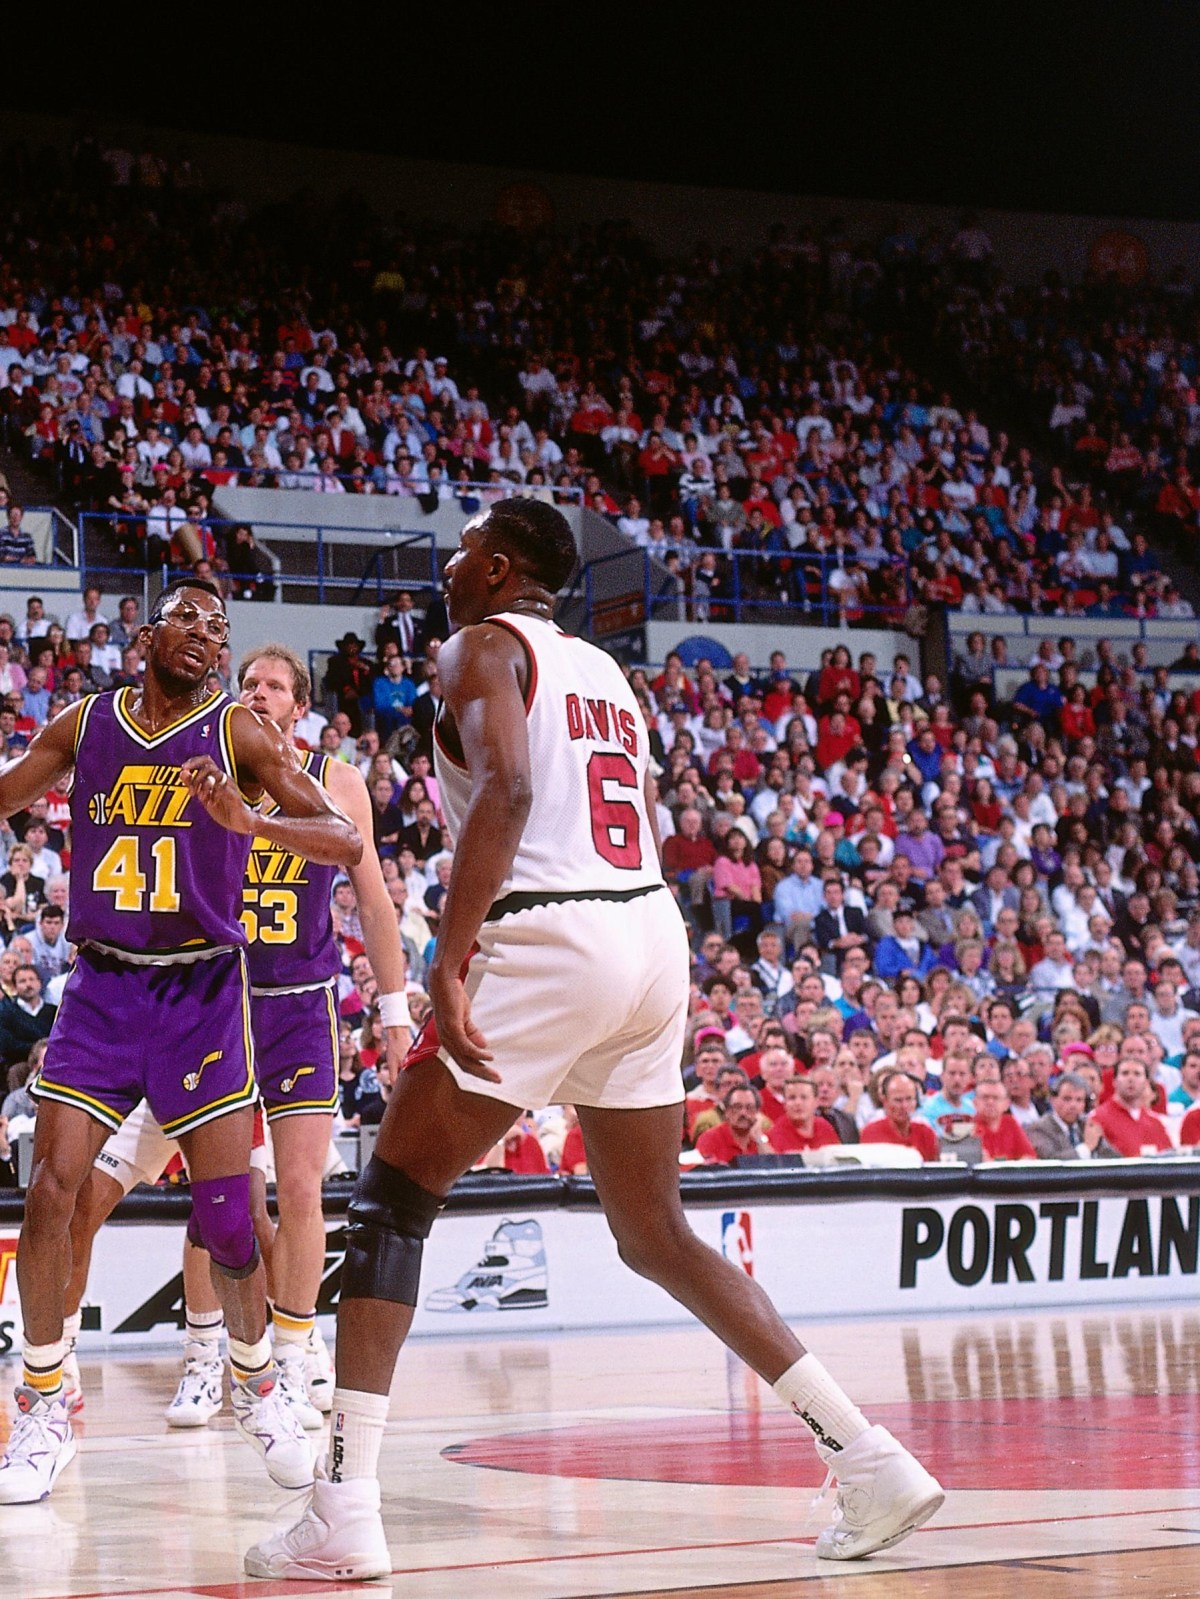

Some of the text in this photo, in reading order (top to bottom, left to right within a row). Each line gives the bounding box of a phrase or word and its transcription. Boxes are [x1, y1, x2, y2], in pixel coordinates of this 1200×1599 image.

[565, 692, 638, 758] DAVIS
[586, 751, 642, 870] 6
[92, 835, 180, 912] 41
